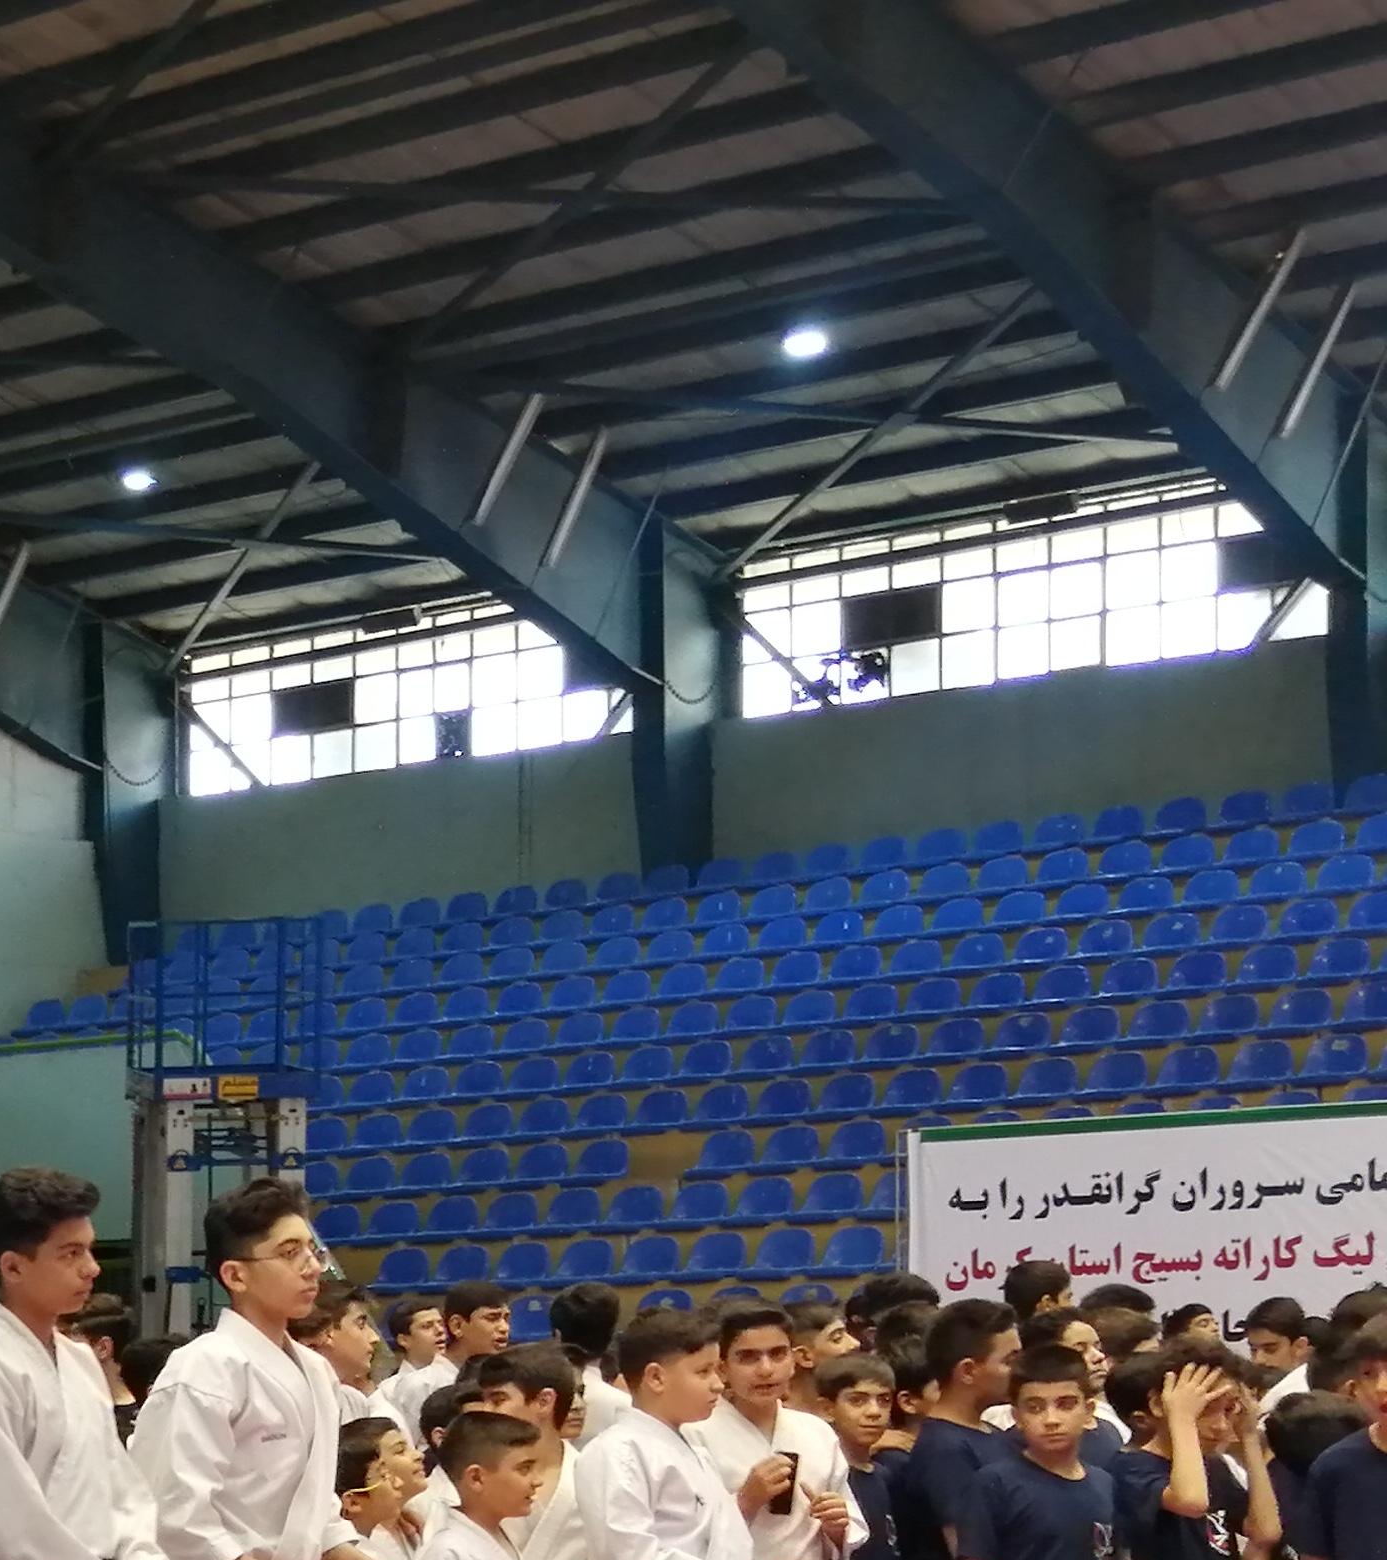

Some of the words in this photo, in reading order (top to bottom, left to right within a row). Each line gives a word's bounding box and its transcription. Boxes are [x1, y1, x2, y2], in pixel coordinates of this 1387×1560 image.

[948, 1187, 989, 1220] به
[1000, 1177, 1025, 1220] را
[1034, 1169, 1161, 1220] گرانقدر
[1172, 1166, 1304, 1212] سروران
[1049, 1242, 1123, 1277] استا
[1132, 1250, 1203, 1284] بسیج
[1213, 1235, 1303, 1281] کاراته
[1313, 1231, 1375, 1275] لیگ
